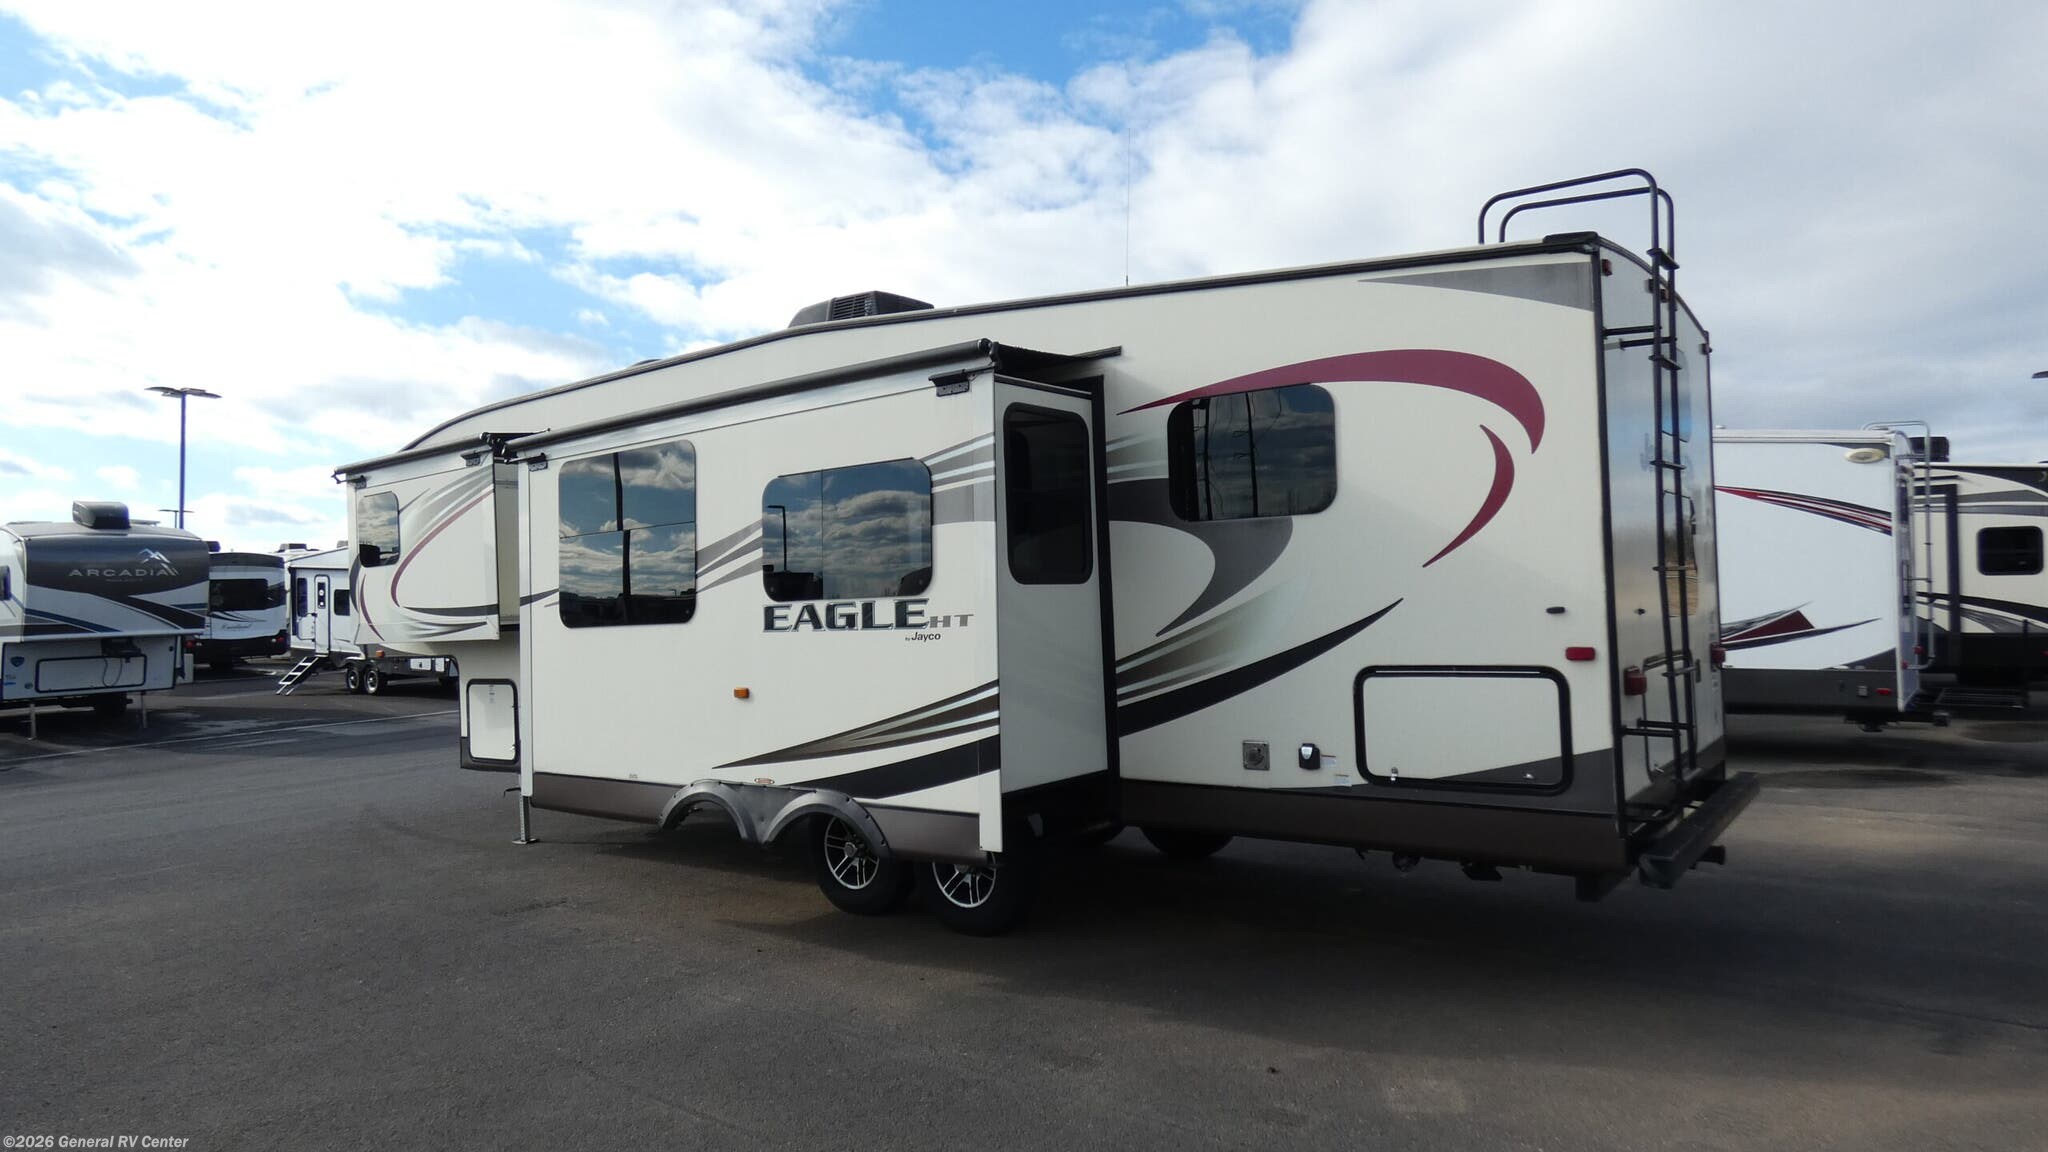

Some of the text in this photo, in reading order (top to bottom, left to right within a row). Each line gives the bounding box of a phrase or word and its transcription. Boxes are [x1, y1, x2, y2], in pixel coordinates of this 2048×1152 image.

[69, 568, 177, 577] ARCADIA
[763, 598, 974, 632] EAGLE HT
[911, 631, 941, 643] Jayco
